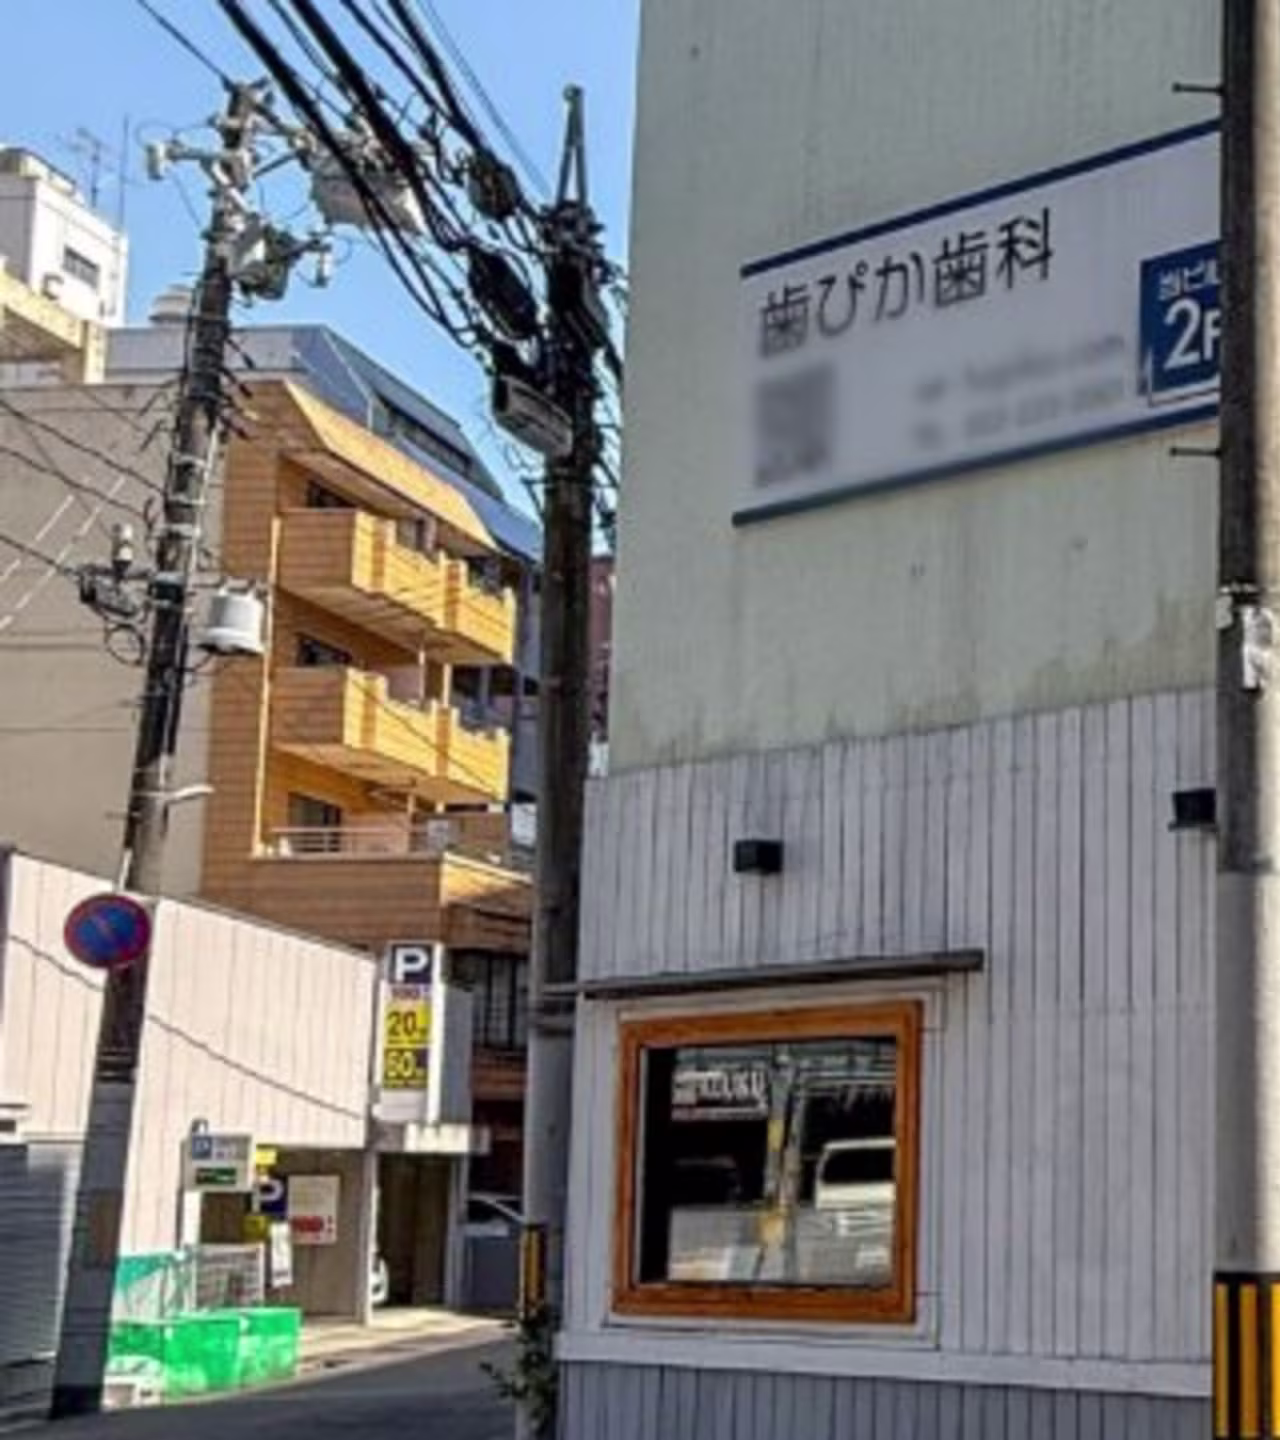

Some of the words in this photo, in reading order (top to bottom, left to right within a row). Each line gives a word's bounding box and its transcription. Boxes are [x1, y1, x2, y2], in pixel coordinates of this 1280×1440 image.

[758, 207, 1054, 358] 歯ぴか歯科
[394, 947, 429, 982] P
